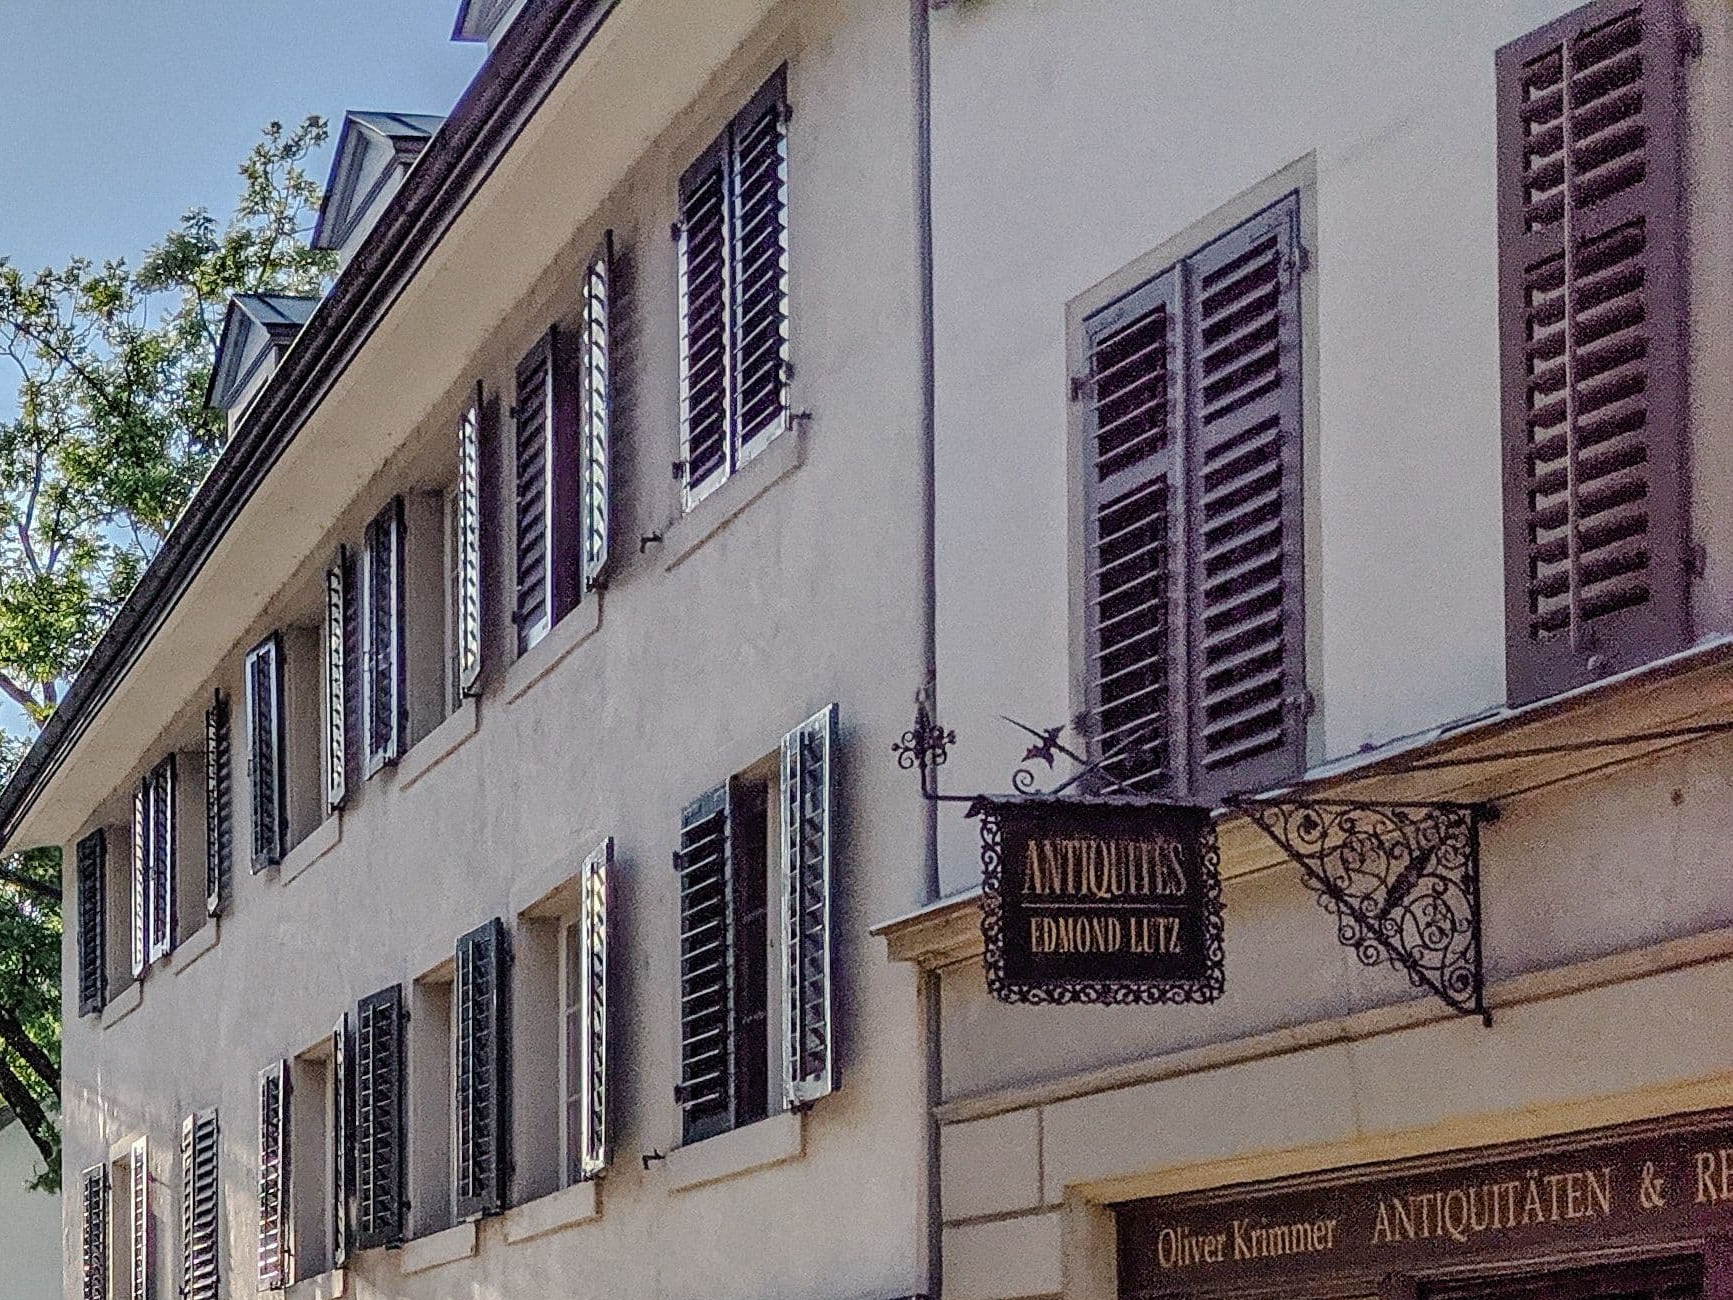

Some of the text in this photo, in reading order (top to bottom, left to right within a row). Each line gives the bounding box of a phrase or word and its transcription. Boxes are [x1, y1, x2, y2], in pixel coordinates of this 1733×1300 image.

[1030, 917, 1182, 954] EDMOND LUTZ
[1158, 1226, 1226, 1268] Oliver
[1233, 1218, 1337, 1260] Krimmer
[1370, 1166, 1613, 1243] ANTIQUITÄTEN
[1639, 1162, 1666, 1208] &
